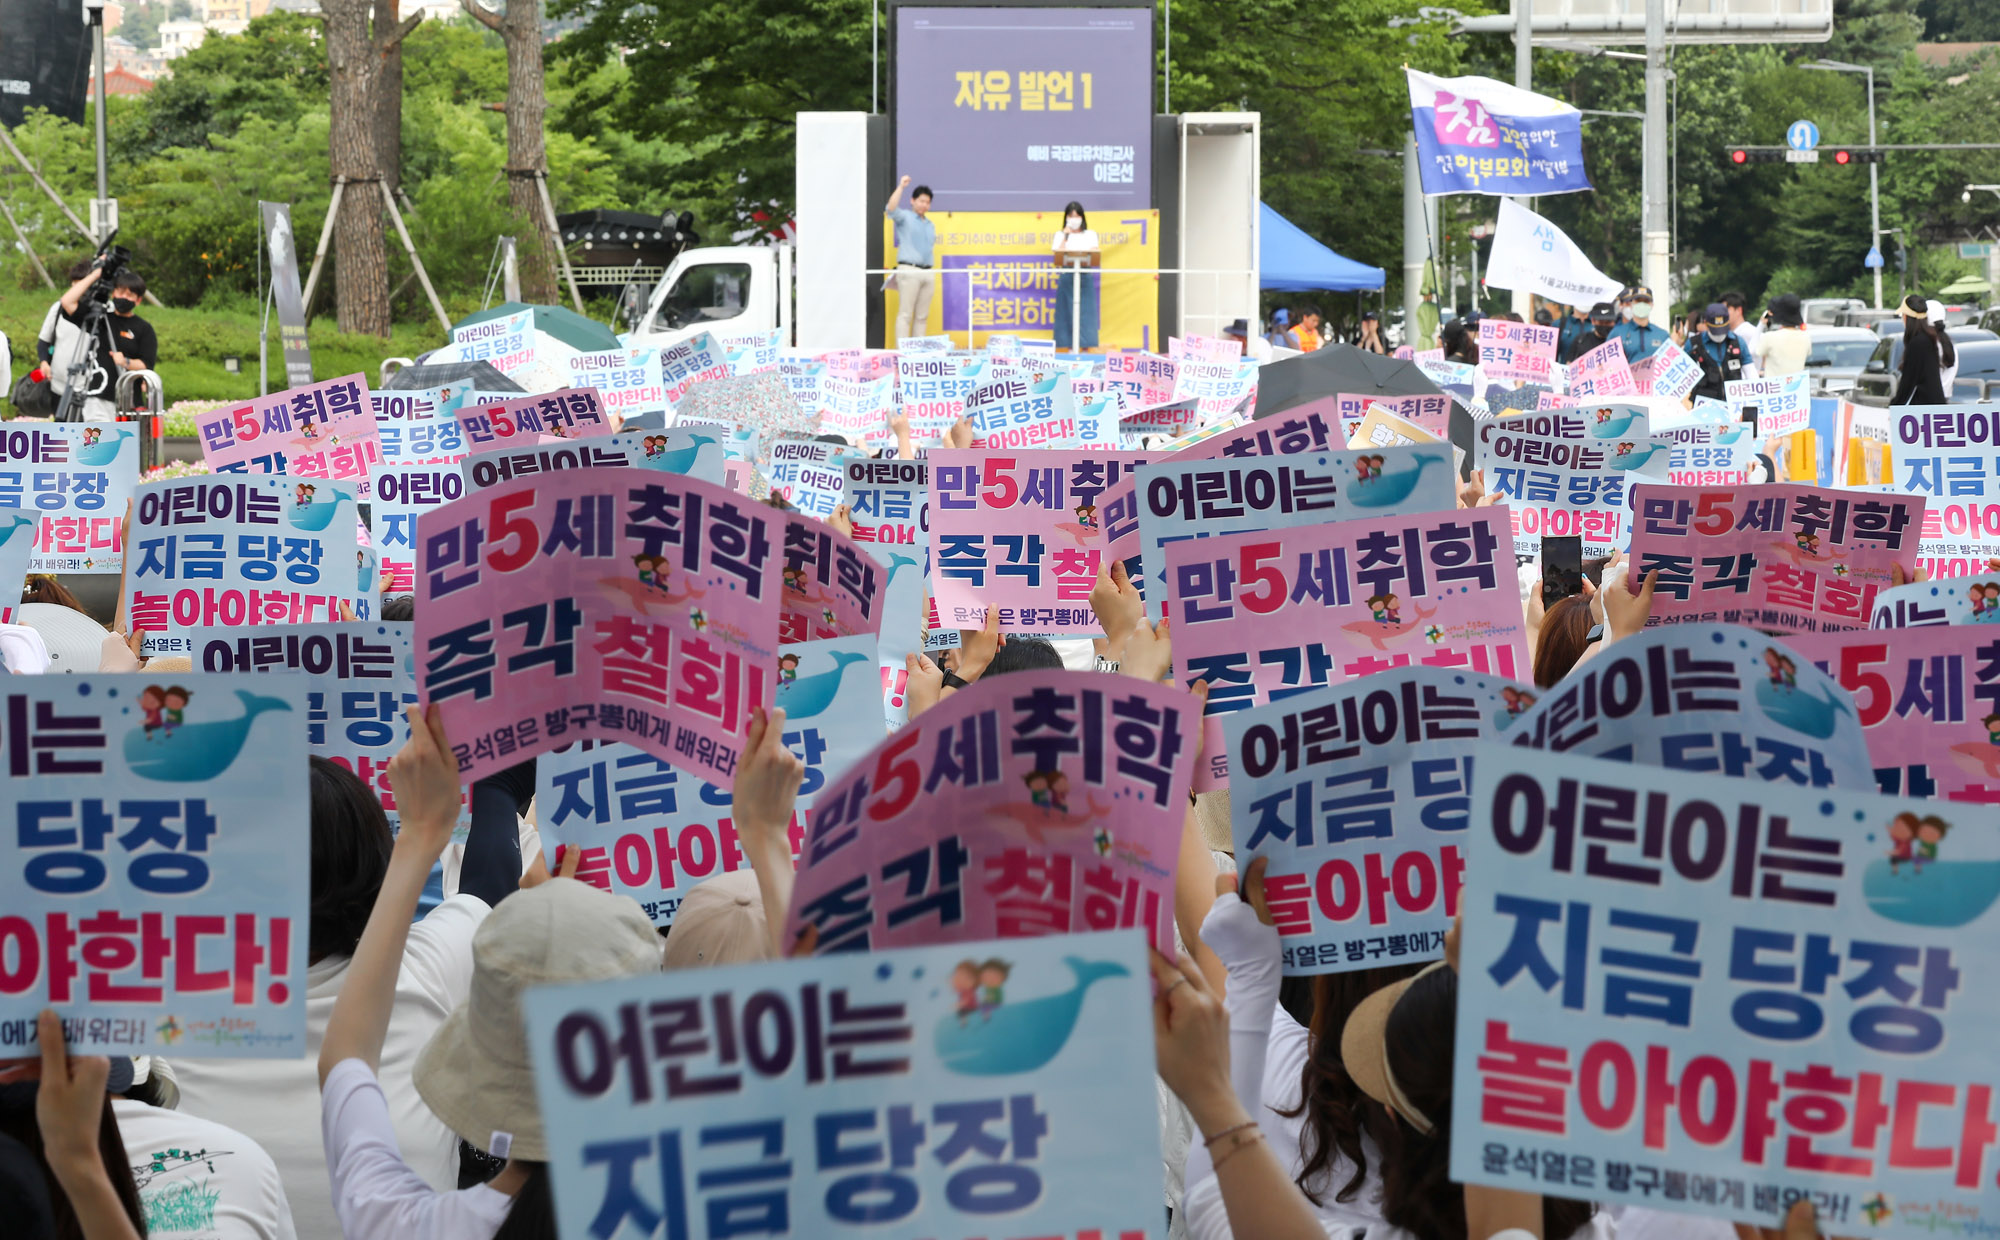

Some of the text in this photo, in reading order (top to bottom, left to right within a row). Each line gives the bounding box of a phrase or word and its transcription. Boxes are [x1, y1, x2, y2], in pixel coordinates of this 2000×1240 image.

[954, 70, 1092, 110] 자유 발언 1
[1436, 94, 1496, 145] 참
[1094, 163, 1134, 183] 이은선
[971, 298, 1056, 327] 철회하
[457, 322, 506, 344] 어린이는
[460, 333, 524, 363] 지금 당장
[570, 354, 626, 371] 어린이는
[661, 345, 692, 367] 린이는
[686, 351, 714, 372] 당장
[902, 361, 957, 378] 어린이는
[1183, 364, 1233, 379] 어린이는
[1481, 346, 1514, 364] 즉각
[611, 367, 646, 388] 당장
[903, 381, 938, 399] 지금
[1728, 381, 1781, 398] 어린이는
[370, 396, 434, 421] 린이는
[966, 380, 1027, 409] 어린이는
[1768, 393, 1798, 411] 당장
[966, 395, 1053, 432] 지금 당장
[1078, 420, 1099, 440] 장
[1759, 408, 1808, 431] 야한다!
[378, 421, 462, 456] 금 당장
[774, 443, 828, 462] 어린이는
[1494, 435, 1604, 471] 어린이는
[850, 463, 928, 485] 어린이
[1668, 447, 1733, 468] 금 당장
[33, 471, 110, 511] 당장
[1491, 466, 1560, 503] 지금
[1904, 456, 1986, 497] 지금
[139, 483, 281, 527] 어린이는
[851, 488, 912, 519] 지금
[1148, 466, 1336, 521] 어린이는
[1511, 506, 1621, 543] 아야한
[46, 557, 81, 571] 배워라!
[135, 534, 227, 581] 지금
[238, 533, 324, 585] 당장
[937, 534, 1045, 588] 즉각
[1582, 545, 1606, 559] 워라!
[1637, 552, 1757, 601] 즉각
[953, 607, 1015, 627] 윤석은
[1723, 610, 1817, 632] 방구뽕에게
[143, 637, 182, 654] 석열은
[203, 632, 395, 679] 어린이는
[424, 597, 583, 704] 즉각
[924, 632, 958, 648] 석열은
[1186, 642, 1334, 716] 즉각
[450, 702, 737, 778] 윤석열은 방구뽕에게 배워라
[1240, 681, 1480, 778] 어린이는
[550, 751, 678, 827] 지금
[1245, 765, 1395, 851] 지금
[16, 798, 217, 894] 당장
[1490, 773, 1844, 908] 어린이는
[799, 834, 969, 953] 즉각
[1279, 943, 1338, 969] 석열은
[1486, 893, 1960, 1056] 지금 당장
[555, 981, 913, 1104] 어린이는
[1477, 1019, 2000, 1190] 놀아야한다
[581, 1093, 1048, 1240] 지금 당장
[1481, 1141, 1597, 1187] 윤석열은
[1604, 1161, 1746, 1211] 방구뽕에게
